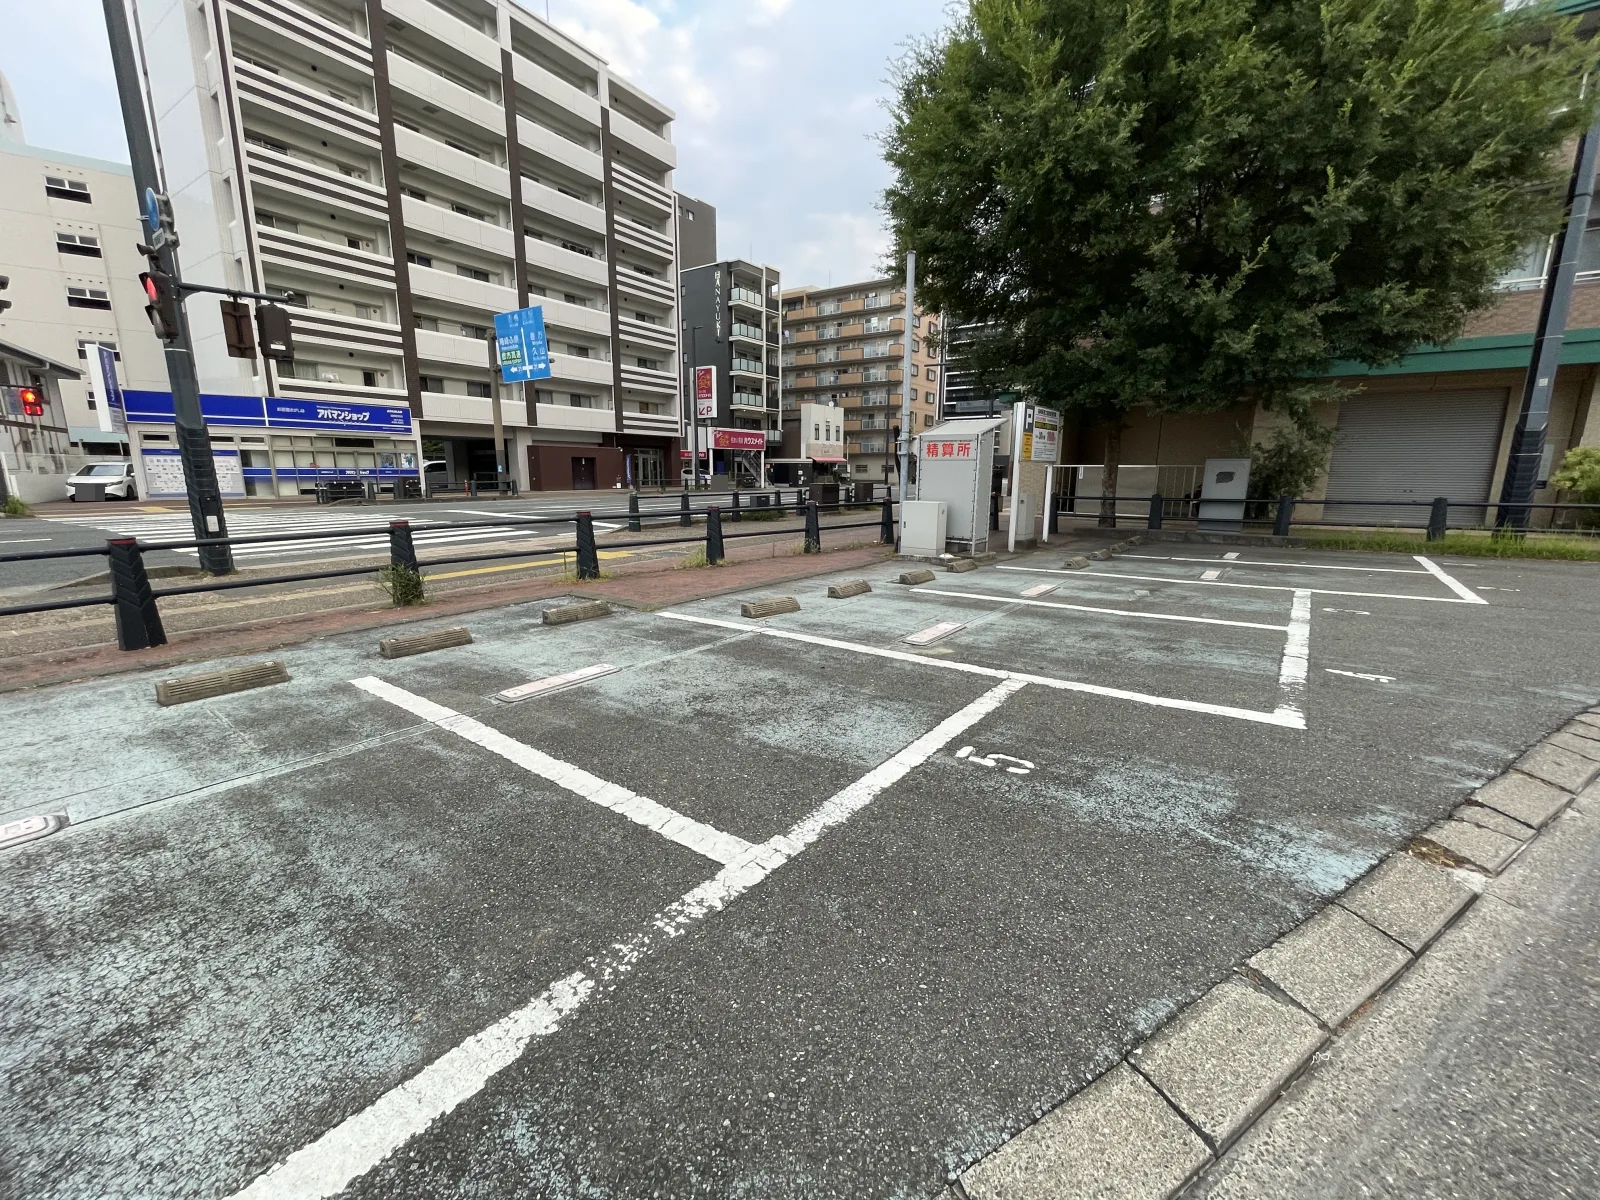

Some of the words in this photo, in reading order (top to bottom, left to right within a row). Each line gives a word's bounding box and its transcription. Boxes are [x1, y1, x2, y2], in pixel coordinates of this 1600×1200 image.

[501, 350, 521, 361] 都市高速
[532, 347, 546, 357] 久山
[316, 408, 371, 421] アパマンショップ
[706, 405, 713, 416] P
[1025, 408, 1034, 429] P
[743, 436, 764, 446] ハウスメイト
[926, 442, 971, 458] 精算所
[954, 745, 1036, 775] 5
